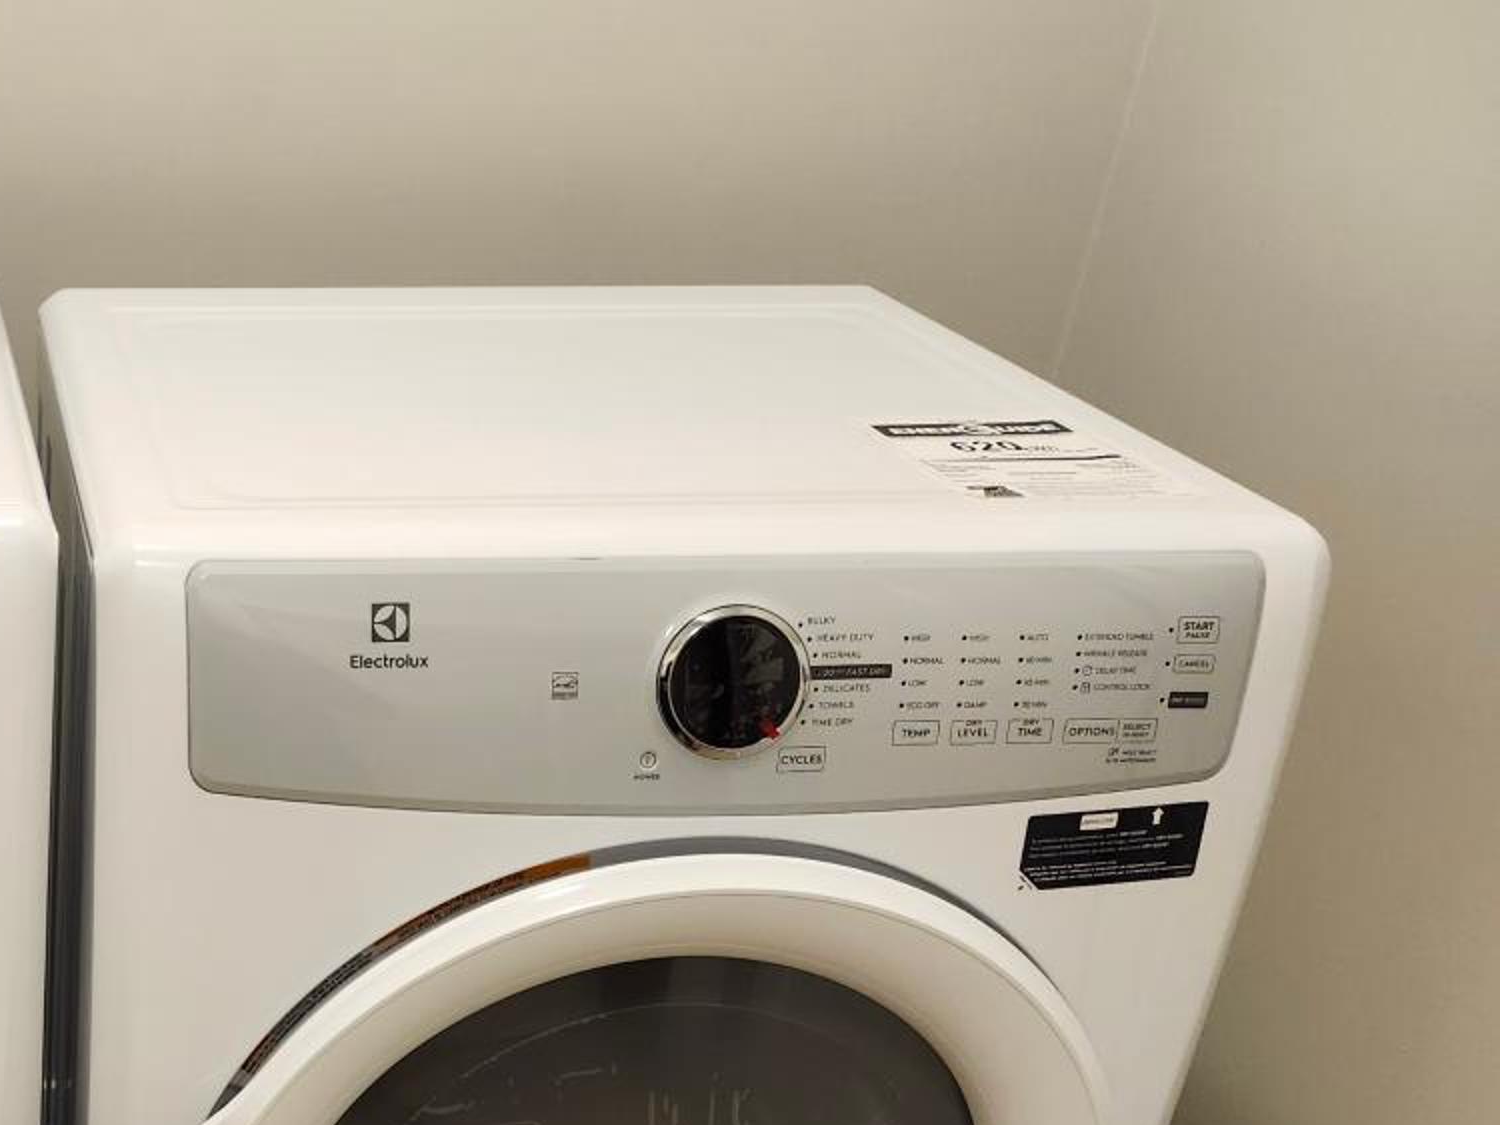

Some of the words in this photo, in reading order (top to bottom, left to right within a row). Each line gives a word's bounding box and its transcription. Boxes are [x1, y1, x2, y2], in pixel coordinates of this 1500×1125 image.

[807, 615, 837, 625] BULKY
[1183, 621, 1215, 631] START
[817, 633, 847, 642] HEAVY
[850, 633, 874, 642] DUTY
[1185, 631, 1210, 639] PAUSE
[821, 651, 861, 659] NORMAL
[350, 654, 429, 670] Electrolux
[909, 657, 944, 665] NORMAL
[823, 684, 870, 693] DELICATES
[902, 728, 931, 738] TEMP
[957, 727, 988, 737] LEVEL
[1018, 727, 1042, 736] TIME
[1069, 726, 1115, 737] OPTIONS
[781, 754, 822, 765] CYCLES
